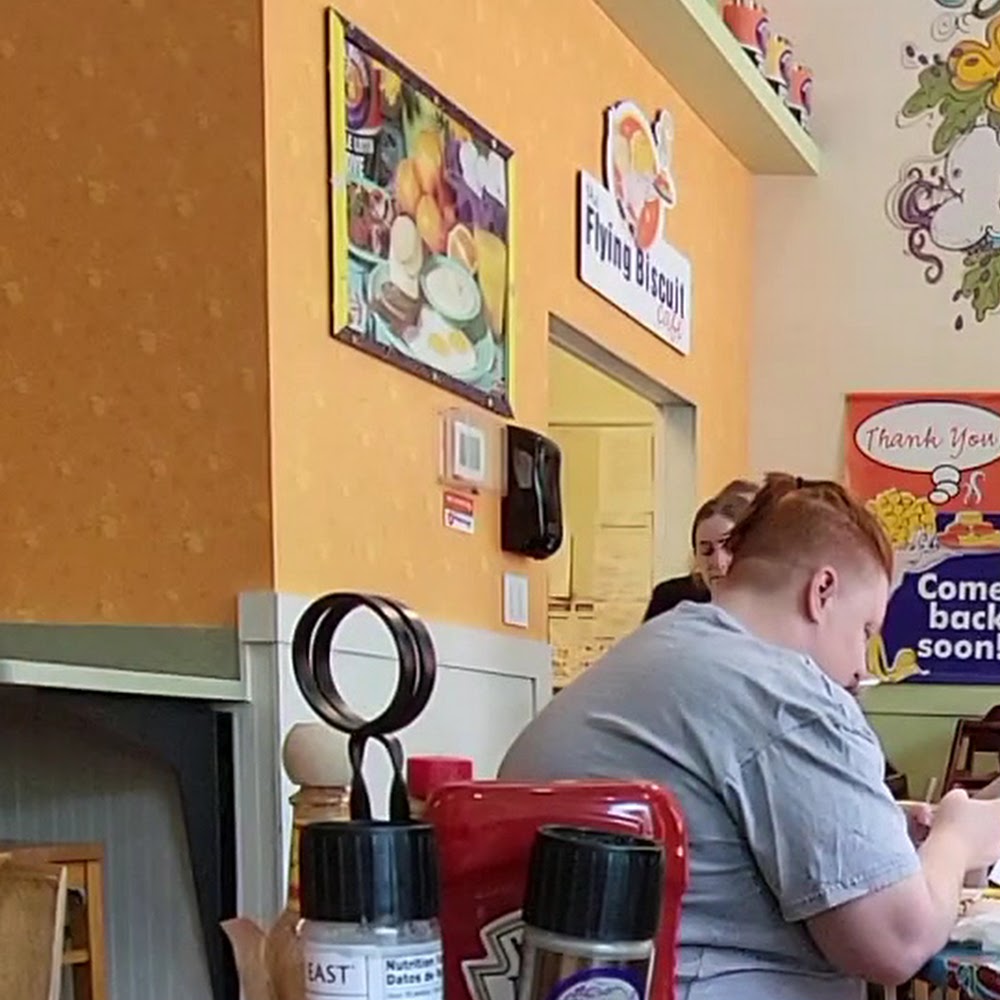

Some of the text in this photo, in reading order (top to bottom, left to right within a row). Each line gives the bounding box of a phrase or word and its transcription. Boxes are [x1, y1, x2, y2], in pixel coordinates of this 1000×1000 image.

[585, 203, 685, 319] Flying Biscuit
[865, 426, 941, 450] Thank
